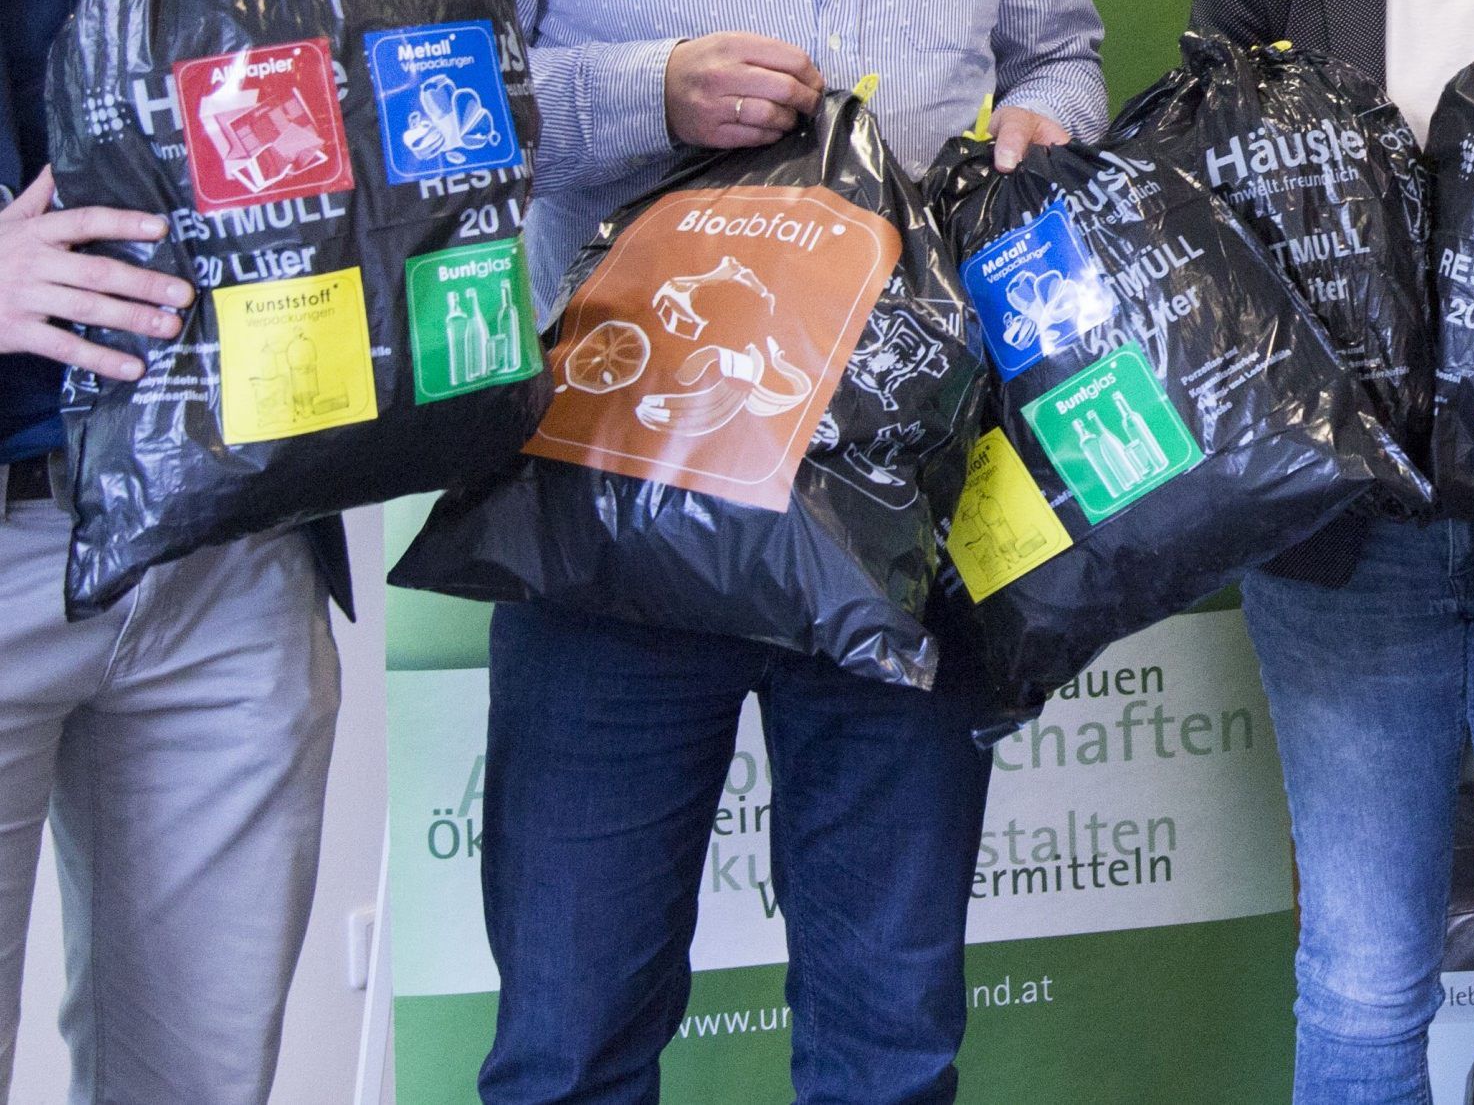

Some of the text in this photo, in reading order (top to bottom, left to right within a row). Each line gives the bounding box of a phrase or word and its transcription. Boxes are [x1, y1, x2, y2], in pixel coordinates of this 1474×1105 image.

[398, 40, 451, 62] Metall
[401, 56, 475, 72] Verpackungen
[1206, 118, 1368, 188] Häusle
[459, 204, 500, 238] 20
[677, 209, 823, 252] Bioabfall
[194, 245, 317, 287] 20 Liter
[438, 257, 512, 282] Buntglas
[982, 239, 1028, 276] Metall
[986, 241, 1052, 284] Verpackungen
[245, 288, 331, 314] Kunststoff
[1055, 372, 1117, 415] Buntglas
[1046, 665, 1164, 702] auen
[993, 700, 1253, 772] chaften
[978, 810, 1178, 869] stalten
[970, 847, 1172, 899] ermitteln
